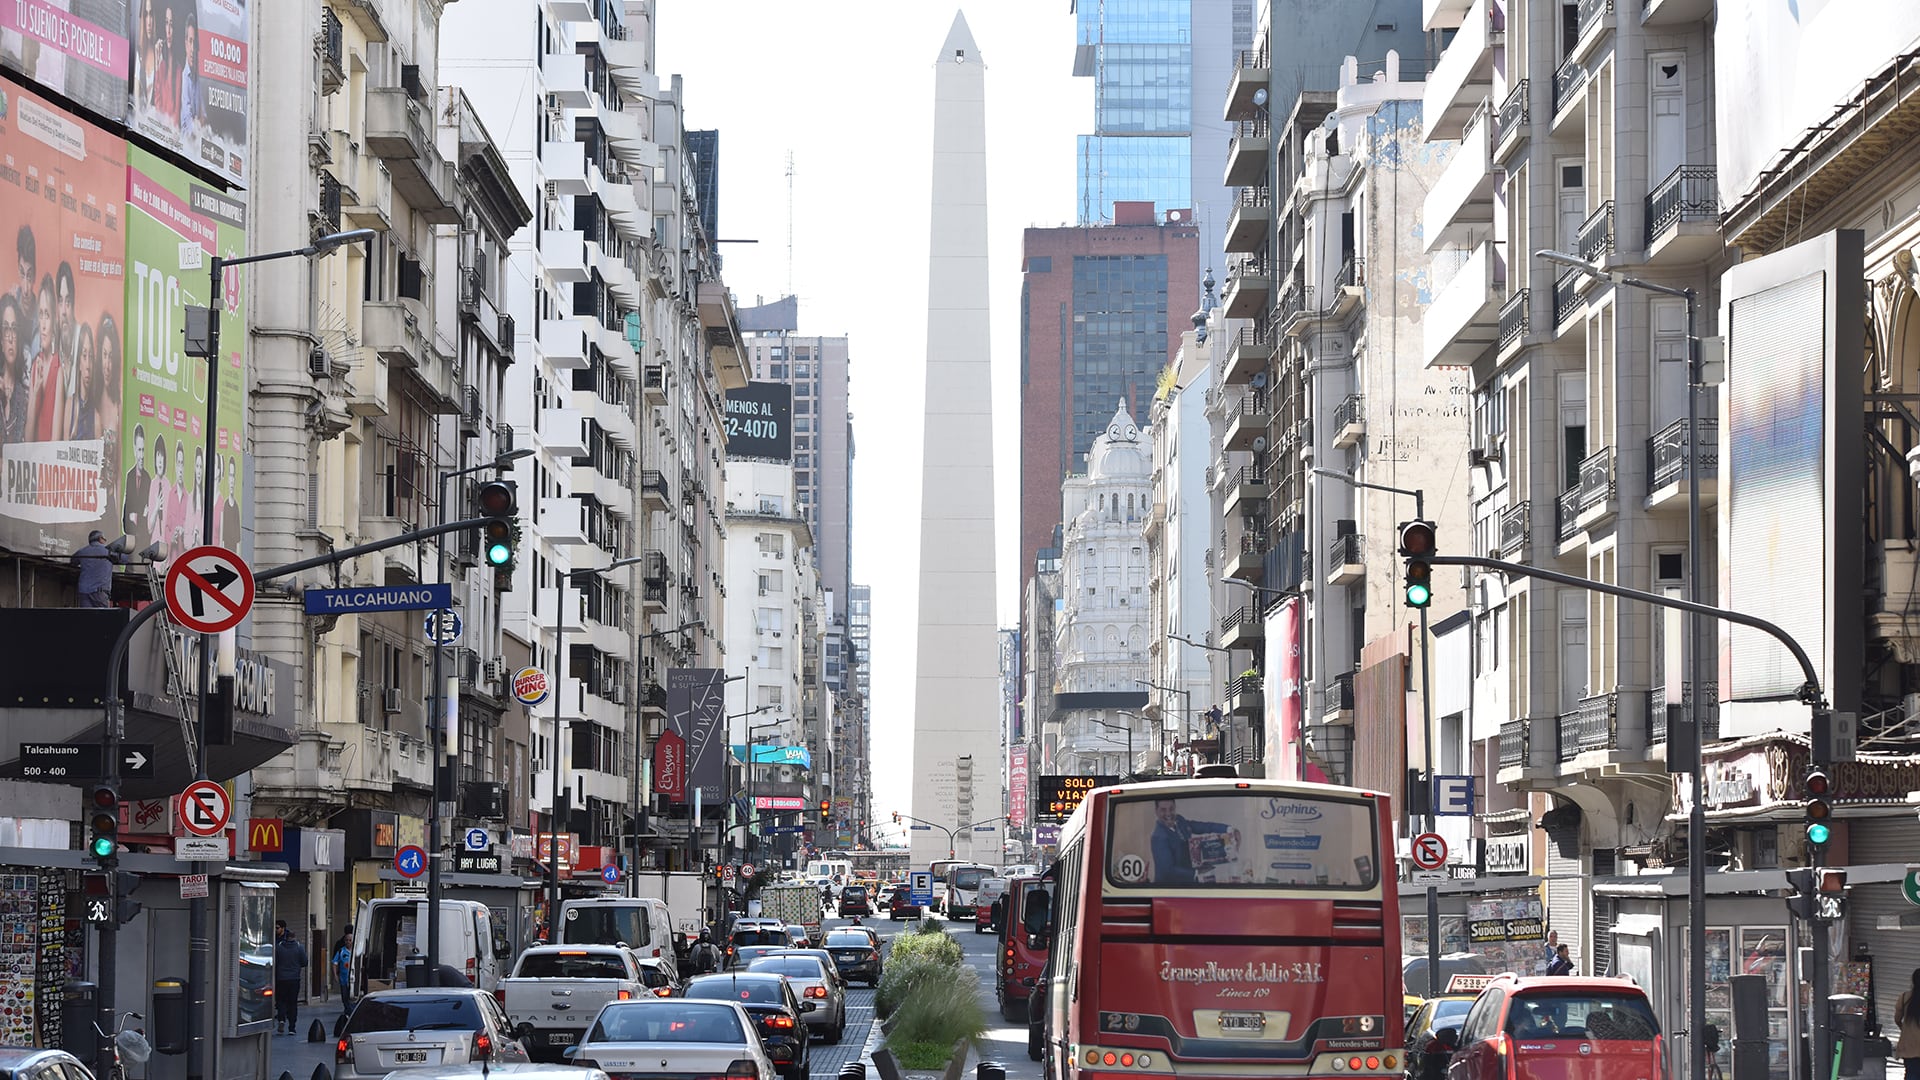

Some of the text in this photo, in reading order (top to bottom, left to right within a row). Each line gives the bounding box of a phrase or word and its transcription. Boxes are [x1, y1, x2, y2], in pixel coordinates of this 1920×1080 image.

[15, 0, 27, 29] TU
[29, 5, 57, 42] SUEÑO
[60, 19, 69, 48] ES
[211, 37, 240, 64] 100.000
[194, 191, 201, 206] LA
[134, 260, 179, 376] TOC
[726, 400, 773, 416] MENOS AL
[325, 590, 432, 608] TALCAHUANO
[515, 673, 545, 687] BURGER
[516, 680, 546, 697] KING
[24, 745, 79, 754] Talcahuano
[663, 744, 676, 776] Vesuvio
[24, 767, 41, 776] 500
[49, 767, 66, 776] 400
[1065, 778, 1094, 787] SOLO
[1439, 779, 1467, 812] E
[195, 792, 215, 824] E
[1260, 797, 1318, 820] Saphirus
[471, 832, 483, 846] E
[1423, 840, 1438, 862] E
[461, 857, 498, 869] HAY LUGAR
[1122, 859, 1142, 877] 60
[181, 874, 207, 884] TAROT
[1453, 867, 1477, 879] LUGAR
[917, 876, 926, 888] E
[568, 911, 577, 919] 110
[1206, 961, 1244, 982] Nueve
[1245, 960, 1257, 981] de
[1257, 962, 1290, 983] Julio
[1253, 988, 1270, 998] 109
[1243, 1017, 1260, 1028] 909
[1328, 1040, 1379, 1048] Mercedes-Benz
